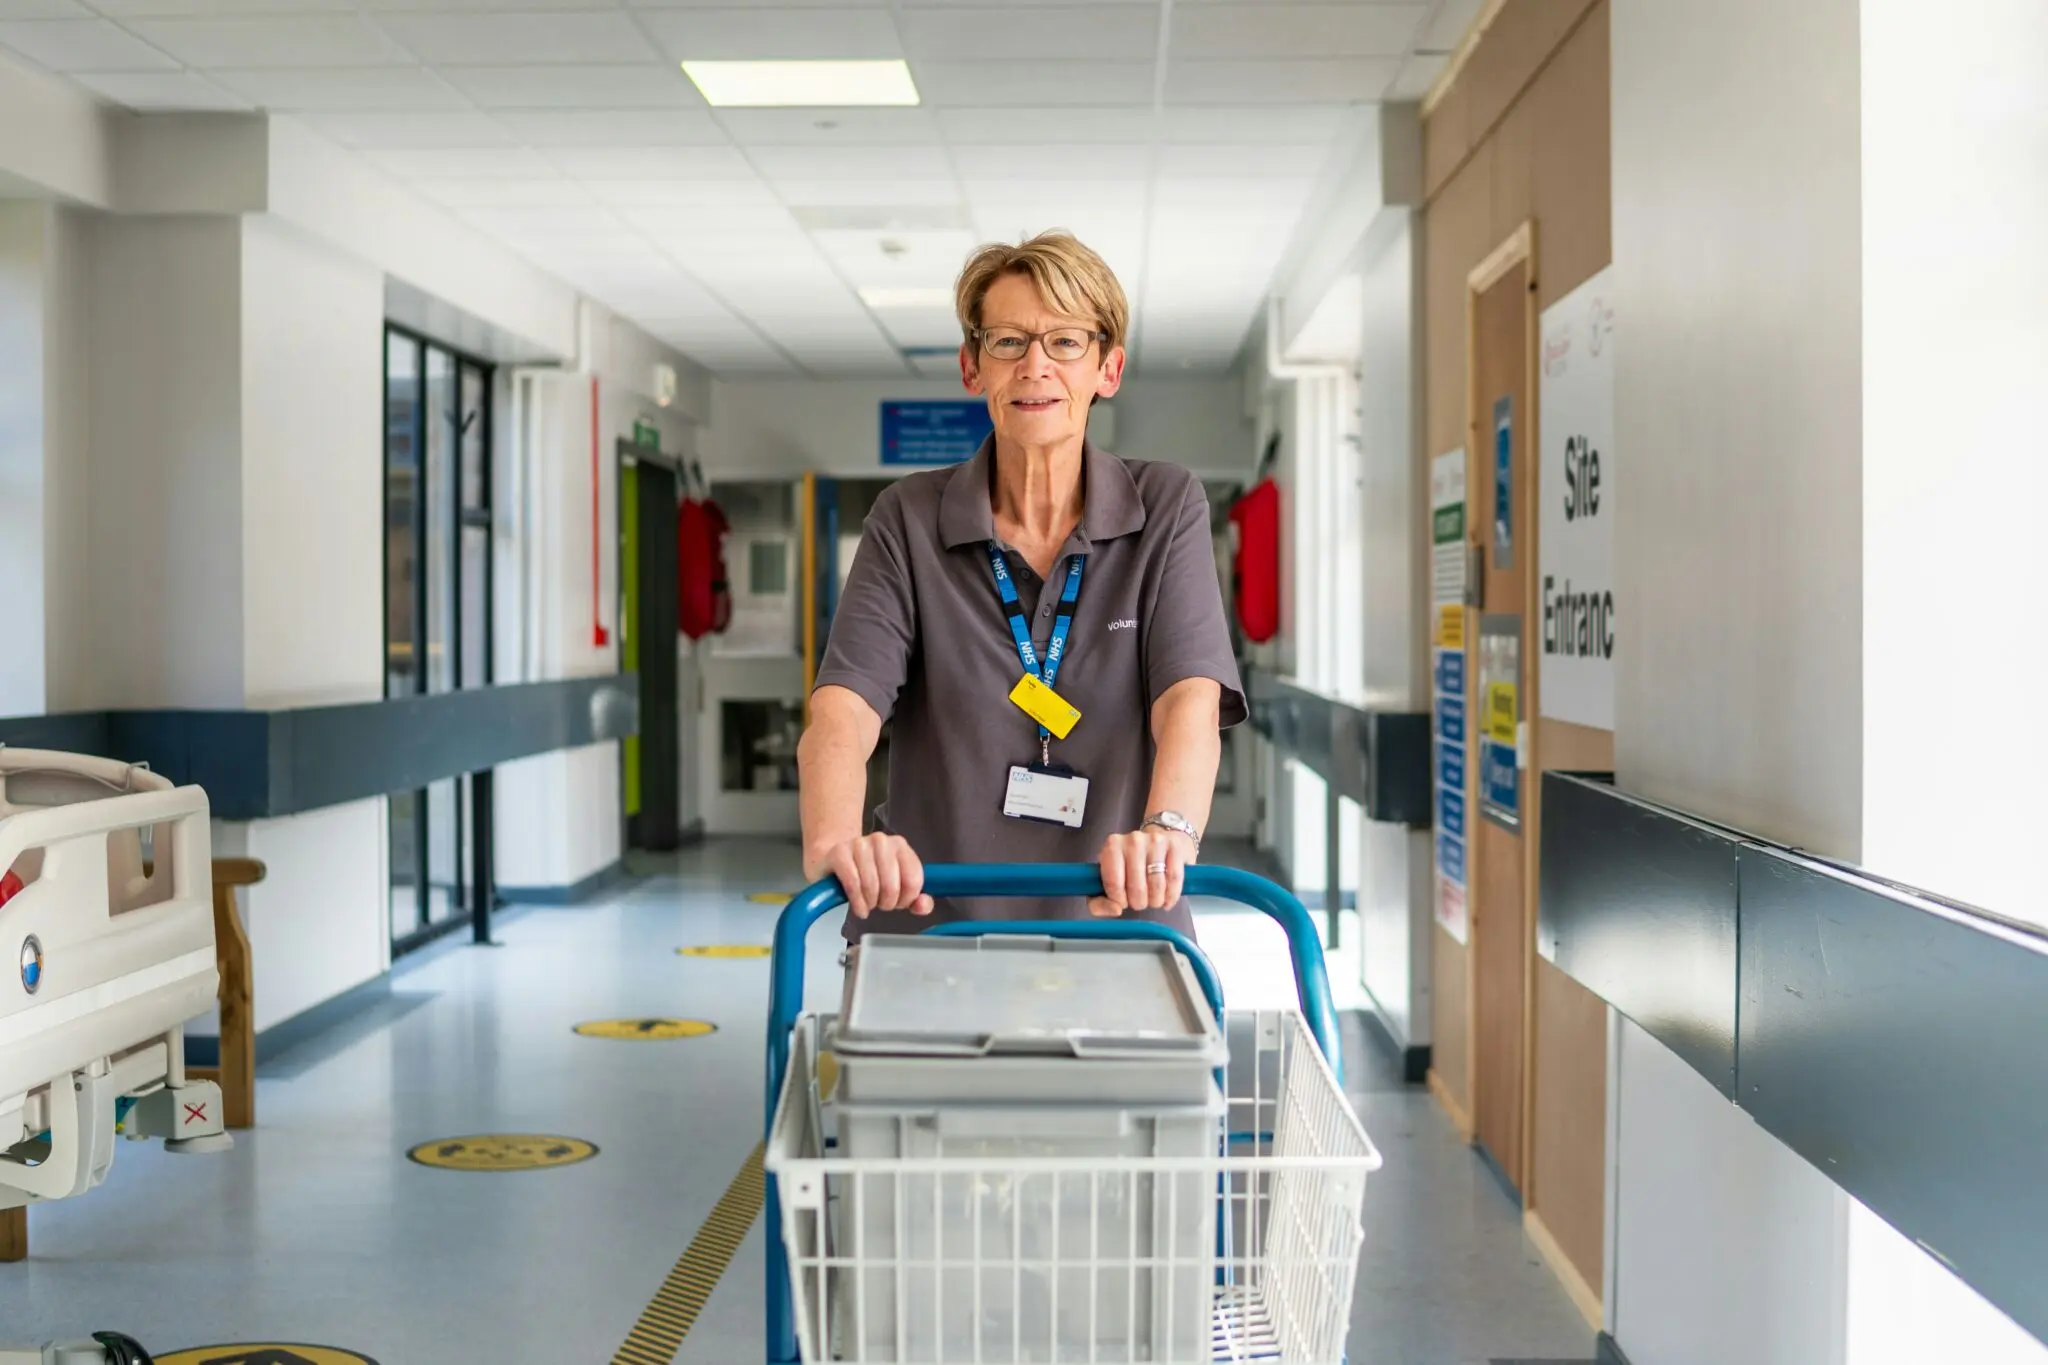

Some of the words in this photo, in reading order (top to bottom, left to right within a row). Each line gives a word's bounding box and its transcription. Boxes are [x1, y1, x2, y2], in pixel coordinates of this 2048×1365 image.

[1564, 434, 1600, 522] Site
[992, 558, 1008, 580] NHS
[1020, 641, 1036, 665] NHS
[1049, 637, 1063, 661] NHS
